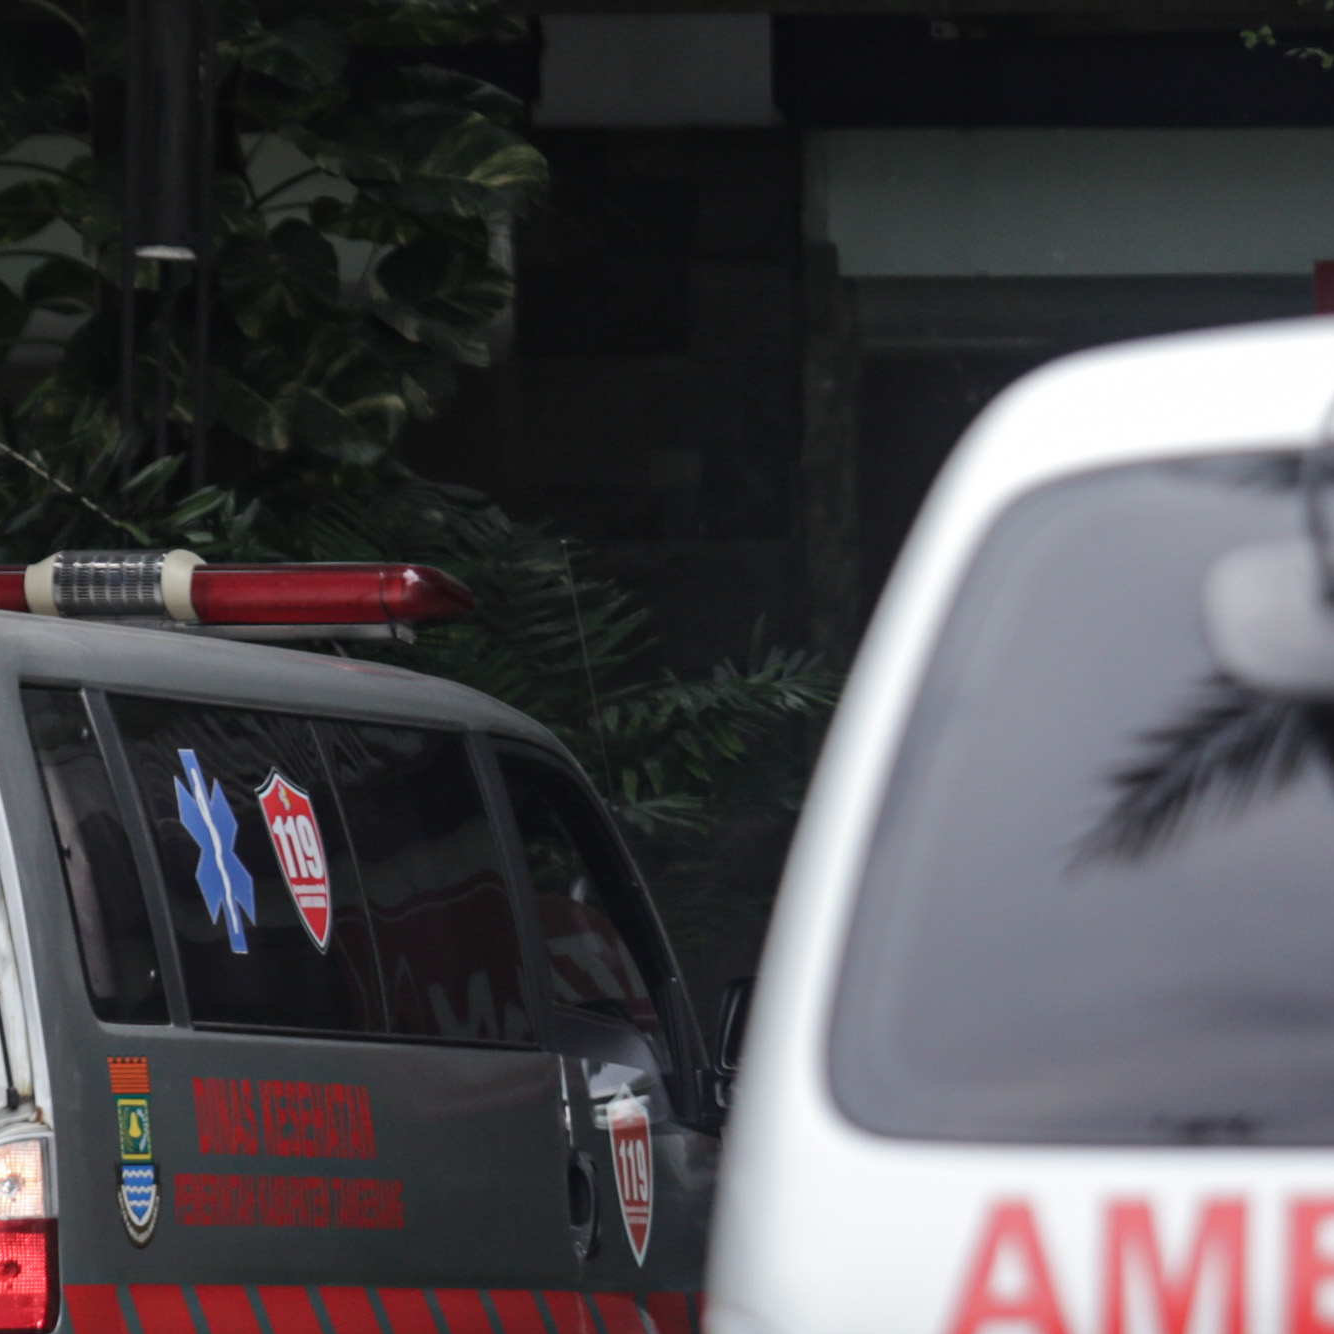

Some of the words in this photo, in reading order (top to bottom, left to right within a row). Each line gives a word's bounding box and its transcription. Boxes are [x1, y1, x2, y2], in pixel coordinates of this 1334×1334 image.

[272, 814, 324, 879] 119
[192, 1076, 259, 1155] DINAS
[258, 1079, 377, 1160] KESEHATAN
[619, 1139, 648, 1202] 119
